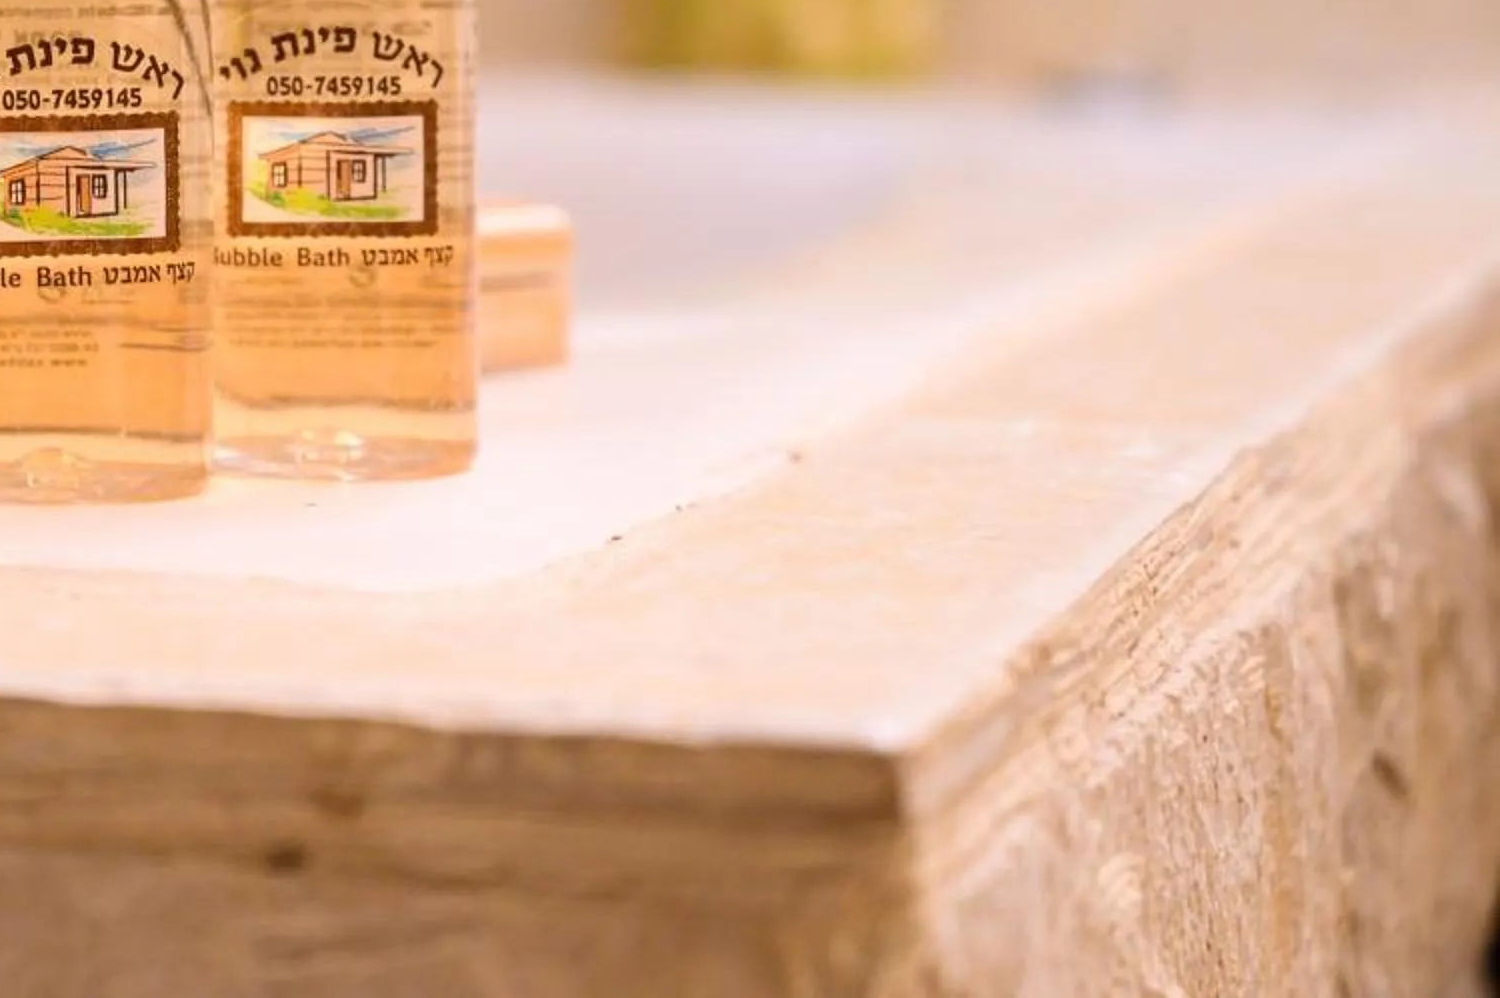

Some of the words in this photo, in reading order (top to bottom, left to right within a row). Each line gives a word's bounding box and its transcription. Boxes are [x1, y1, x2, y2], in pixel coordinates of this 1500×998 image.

[271, 25, 358, 61] פינת
[5, 36, 96, 75] פינת
[219, 47, 263, 82] נוי
[371, 31, 444, 87] ראש
[110, 41, 185, 100] ראש
[266, 75, 401, 96] 050-7459145
[2, 88, 142, 110] 050-7459145
[297, 248, 351, 267] Bath
[361, 249, 419, 267] אמבט
[424, 245, 454, 267] קצף
[37, 267, 92, 287] Bath
[103, 267, 161, 285] אמבט
[166, 261, 196, 287] קצף
